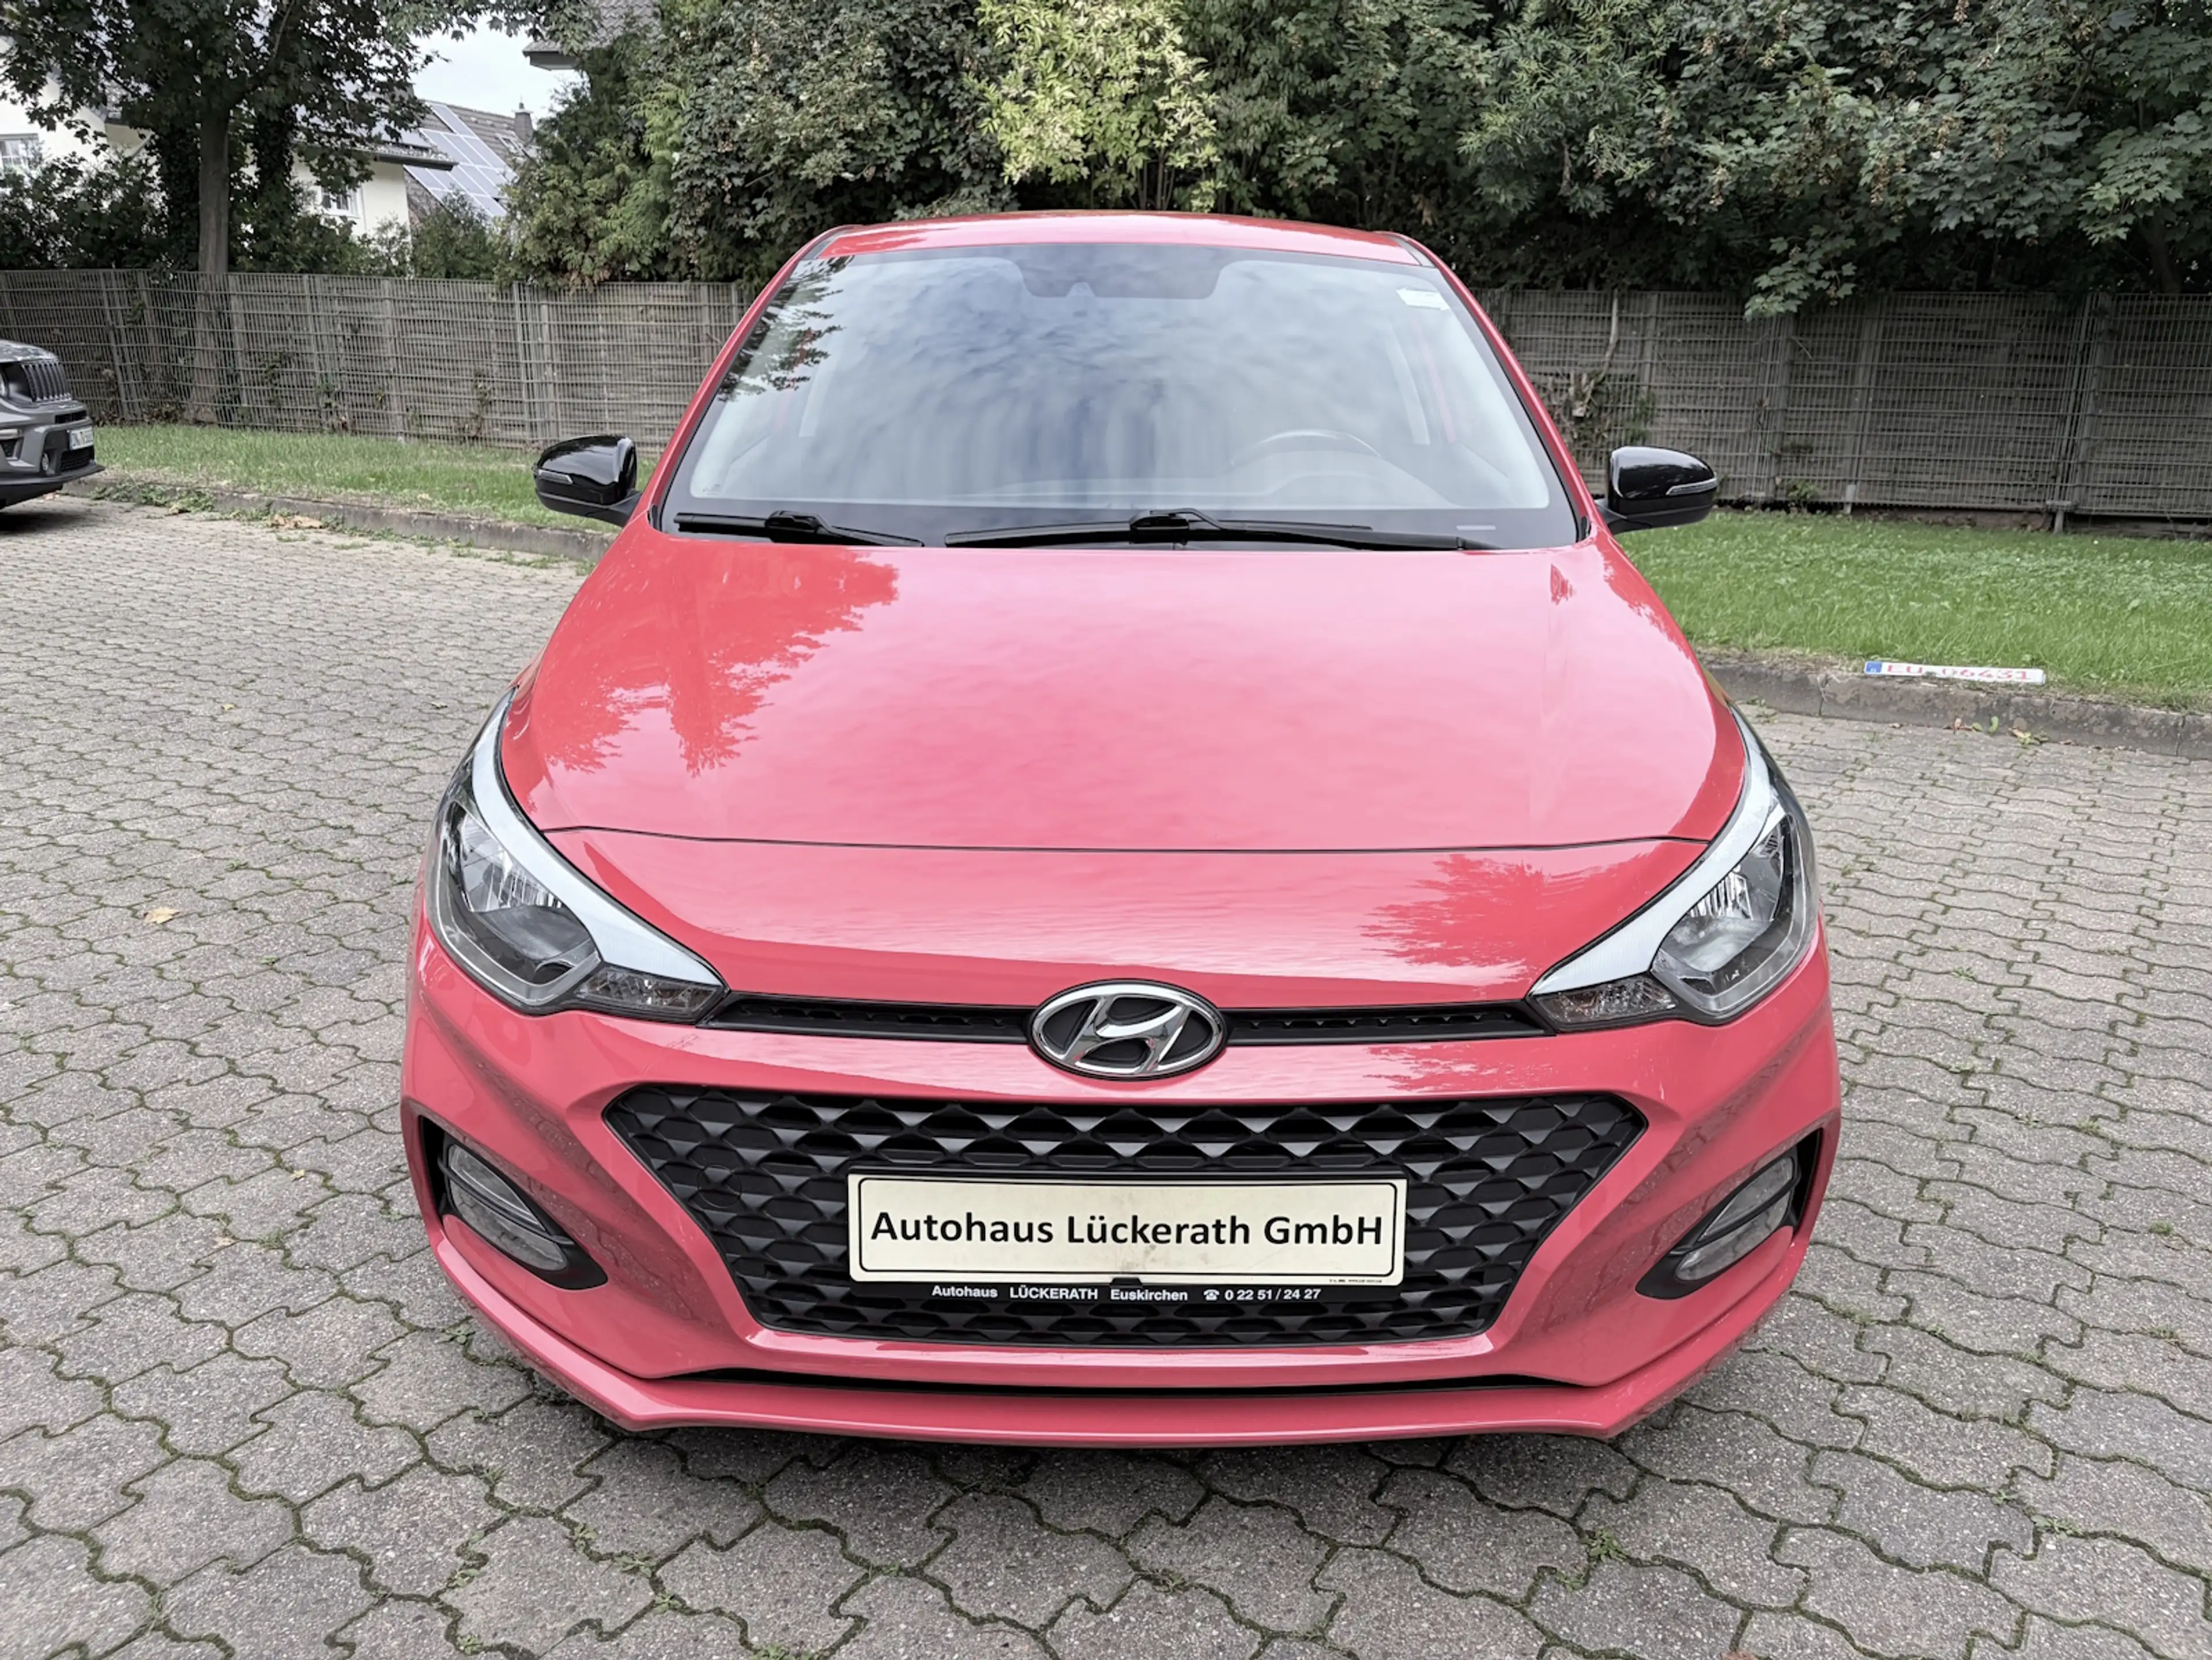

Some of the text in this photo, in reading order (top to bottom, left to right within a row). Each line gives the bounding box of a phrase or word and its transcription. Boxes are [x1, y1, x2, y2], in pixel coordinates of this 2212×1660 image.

[871, 1211, 1382, 1245] Autohaus Lückerath GmbH
[931, 1285, 998, 1298] Autohaus
[1009, 1284, 1098, 1300] LÜCKERATH
[1110, 1289, 1189, 1301] Euskirchen
